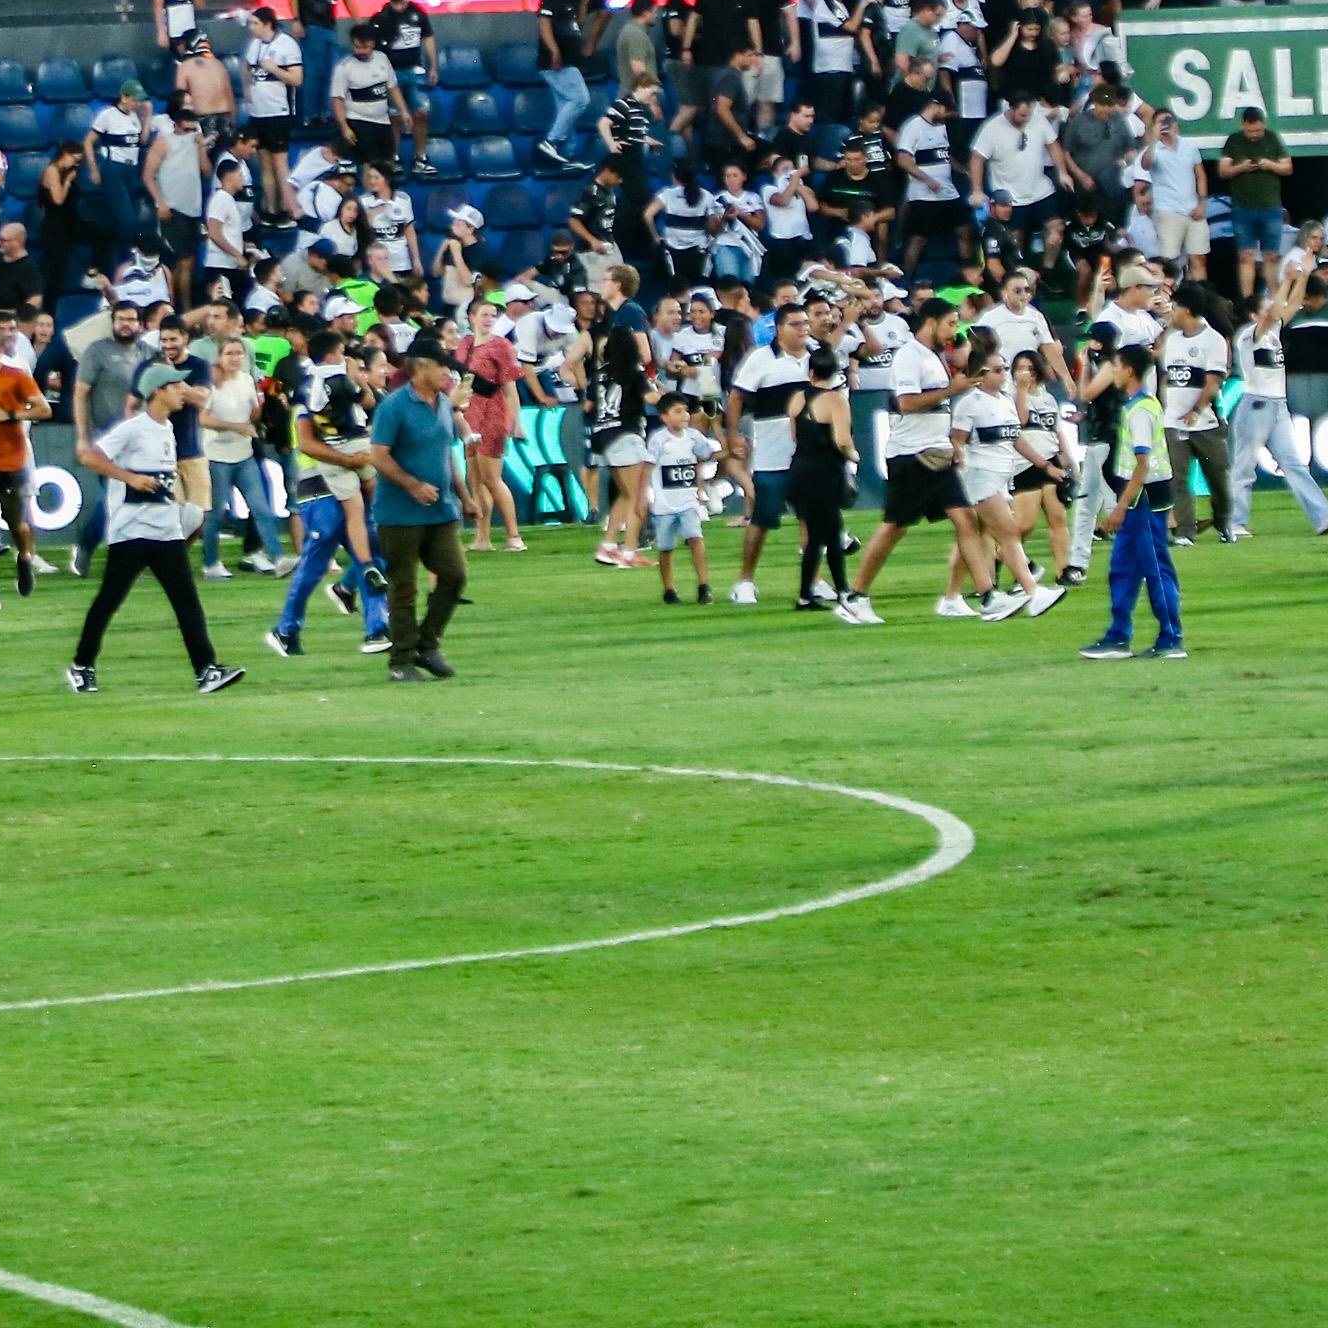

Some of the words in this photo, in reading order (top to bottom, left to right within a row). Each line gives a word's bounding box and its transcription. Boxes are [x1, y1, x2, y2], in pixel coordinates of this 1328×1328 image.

[1168, 369, 1191, 387] tigo
[1001, 426, 1023, 440] tigo
[671, 469, 696, 486] tigo
